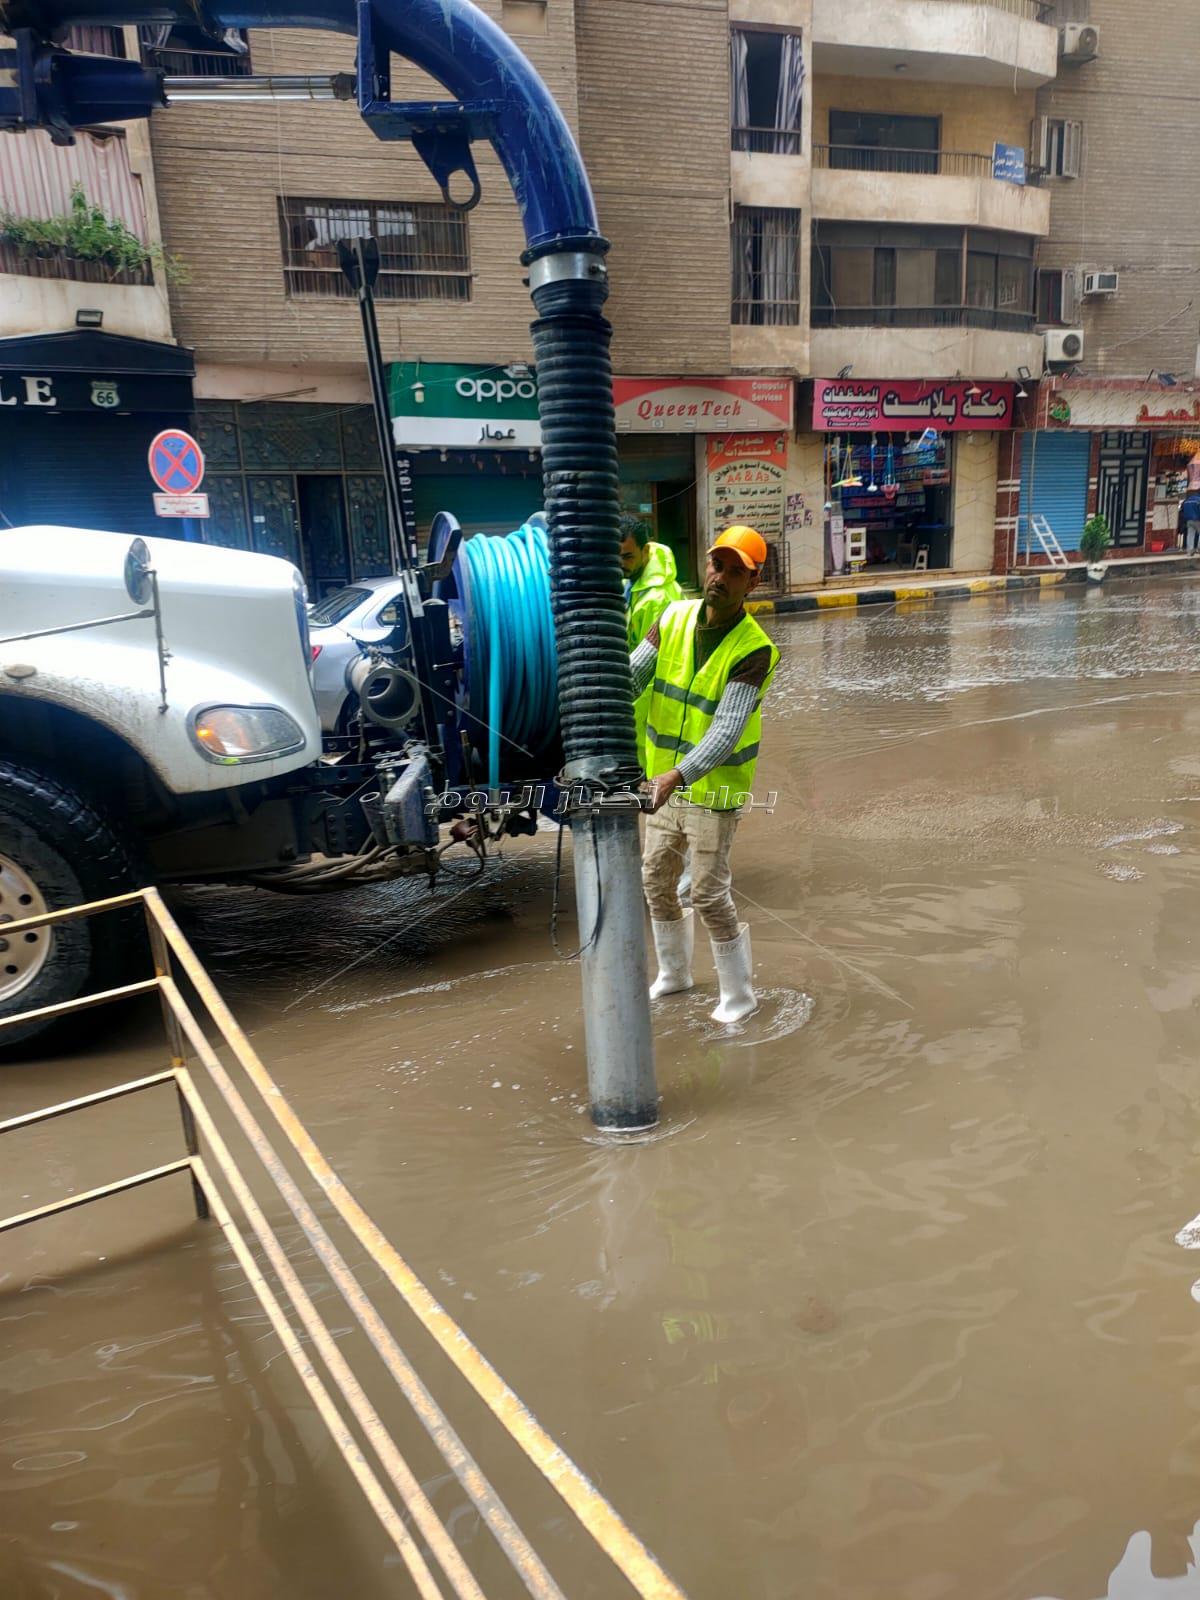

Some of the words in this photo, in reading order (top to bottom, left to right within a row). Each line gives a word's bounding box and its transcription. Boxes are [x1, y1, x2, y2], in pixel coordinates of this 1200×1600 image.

[455, 378, 537, 403] oppo
[752, 382, 787, 391] Computer
[822, 385, 879, 403] للمنظفات
[97, 391, 114, 405] 66
[752, 393, 783, 401] Services
[881, 387, 957, 424] بلاست
[478, 424, 516, 443] عمار
[727, 471, 742, 483] A4
[755, 471, 770, 482] A3
